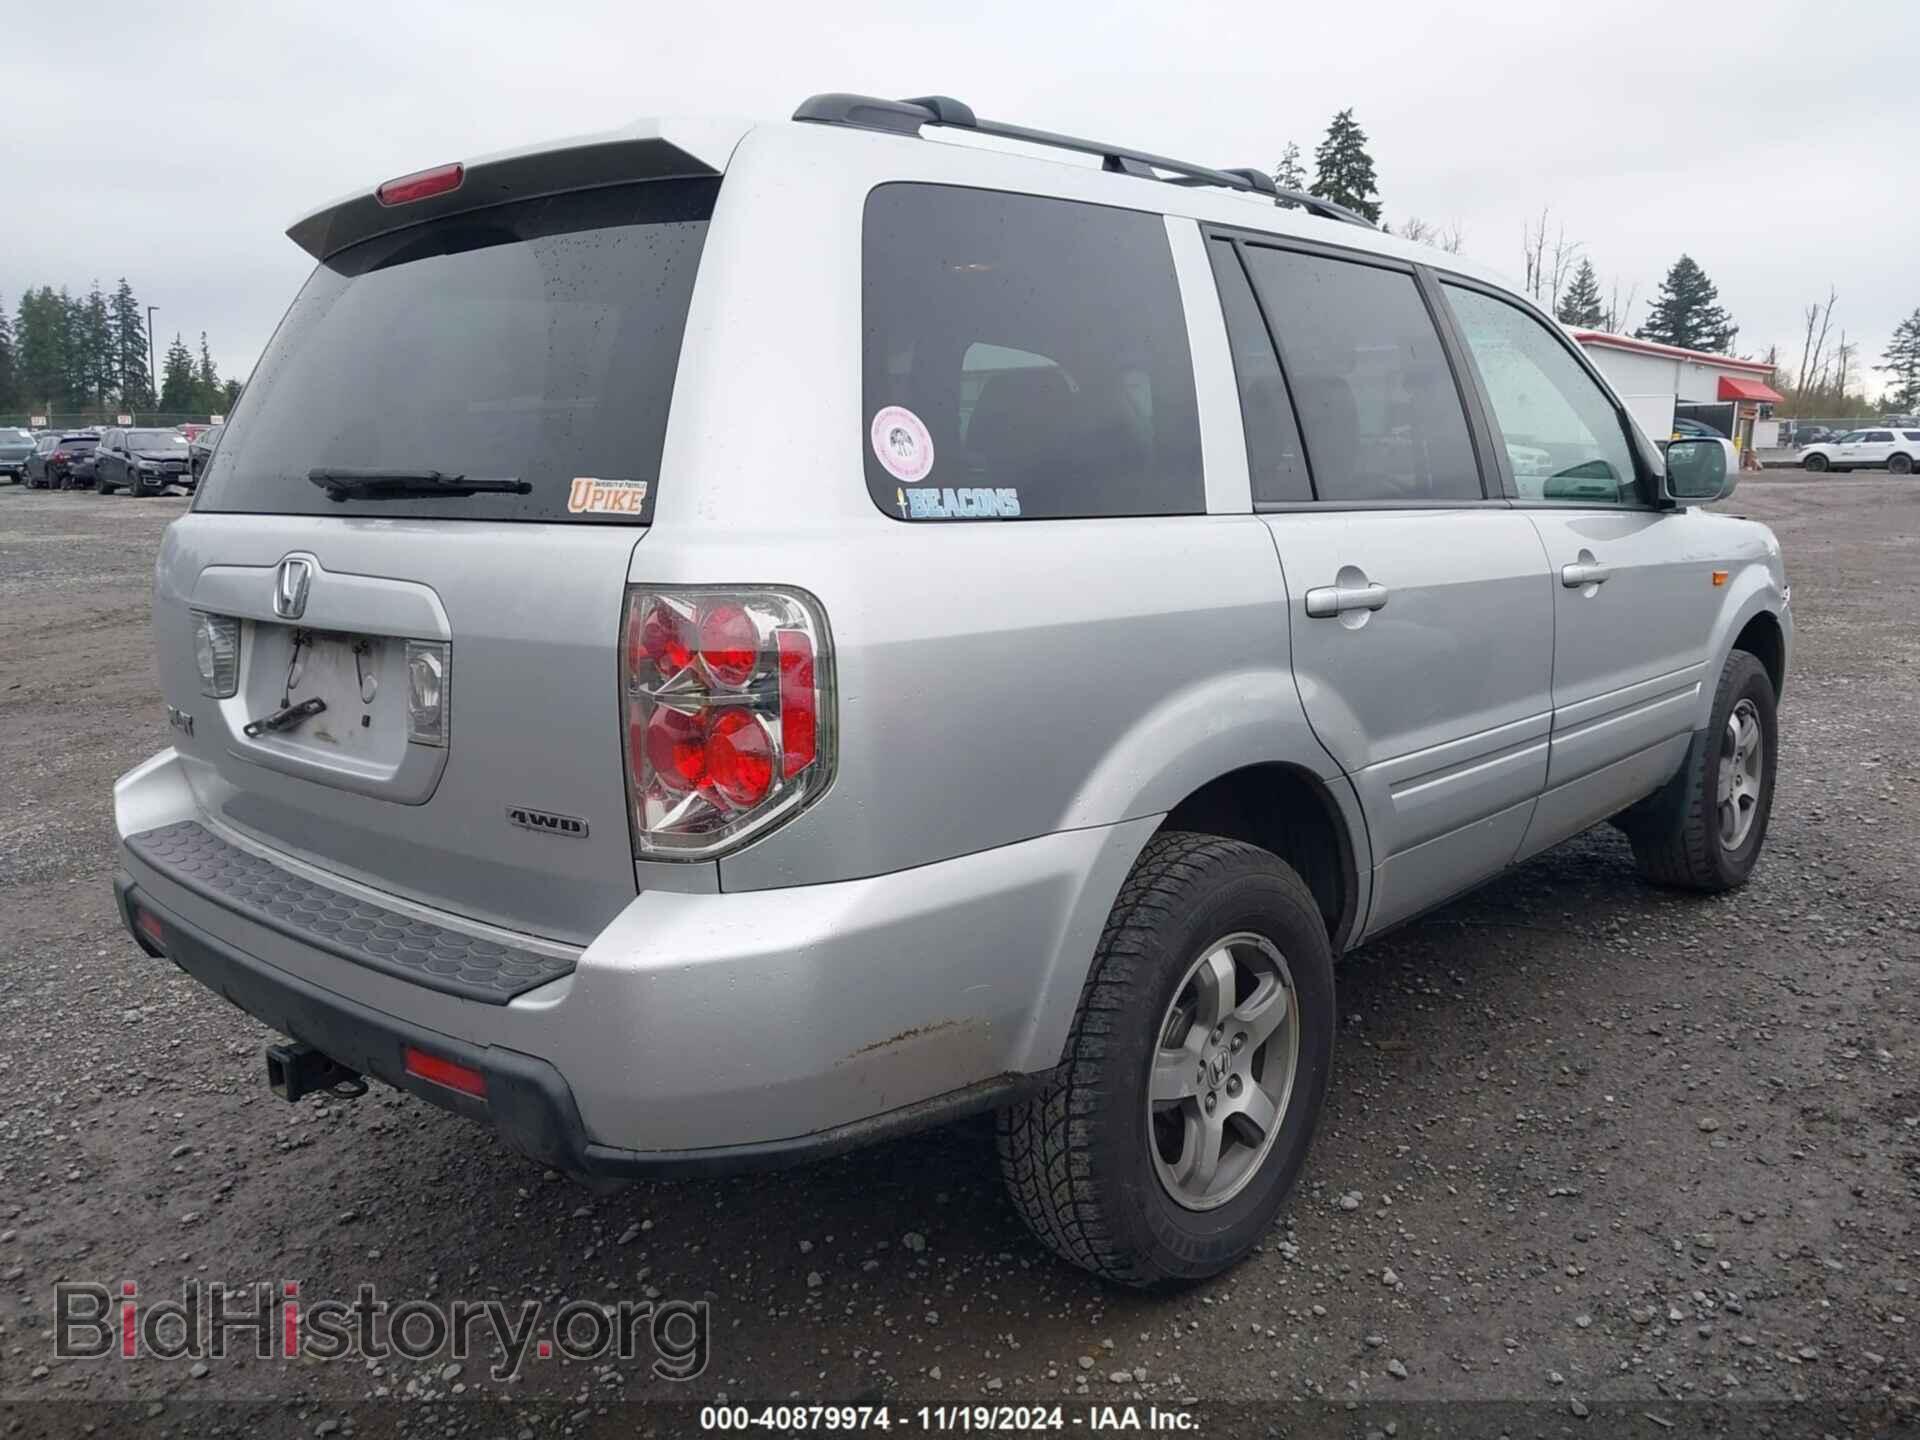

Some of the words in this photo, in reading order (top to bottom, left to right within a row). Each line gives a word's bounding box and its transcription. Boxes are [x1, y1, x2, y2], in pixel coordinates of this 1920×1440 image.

[570, 479, 643, 512] UPIKE
[906, 488, 1021, 518] BEACONS
[509, 809, 582, 833] 4WD
